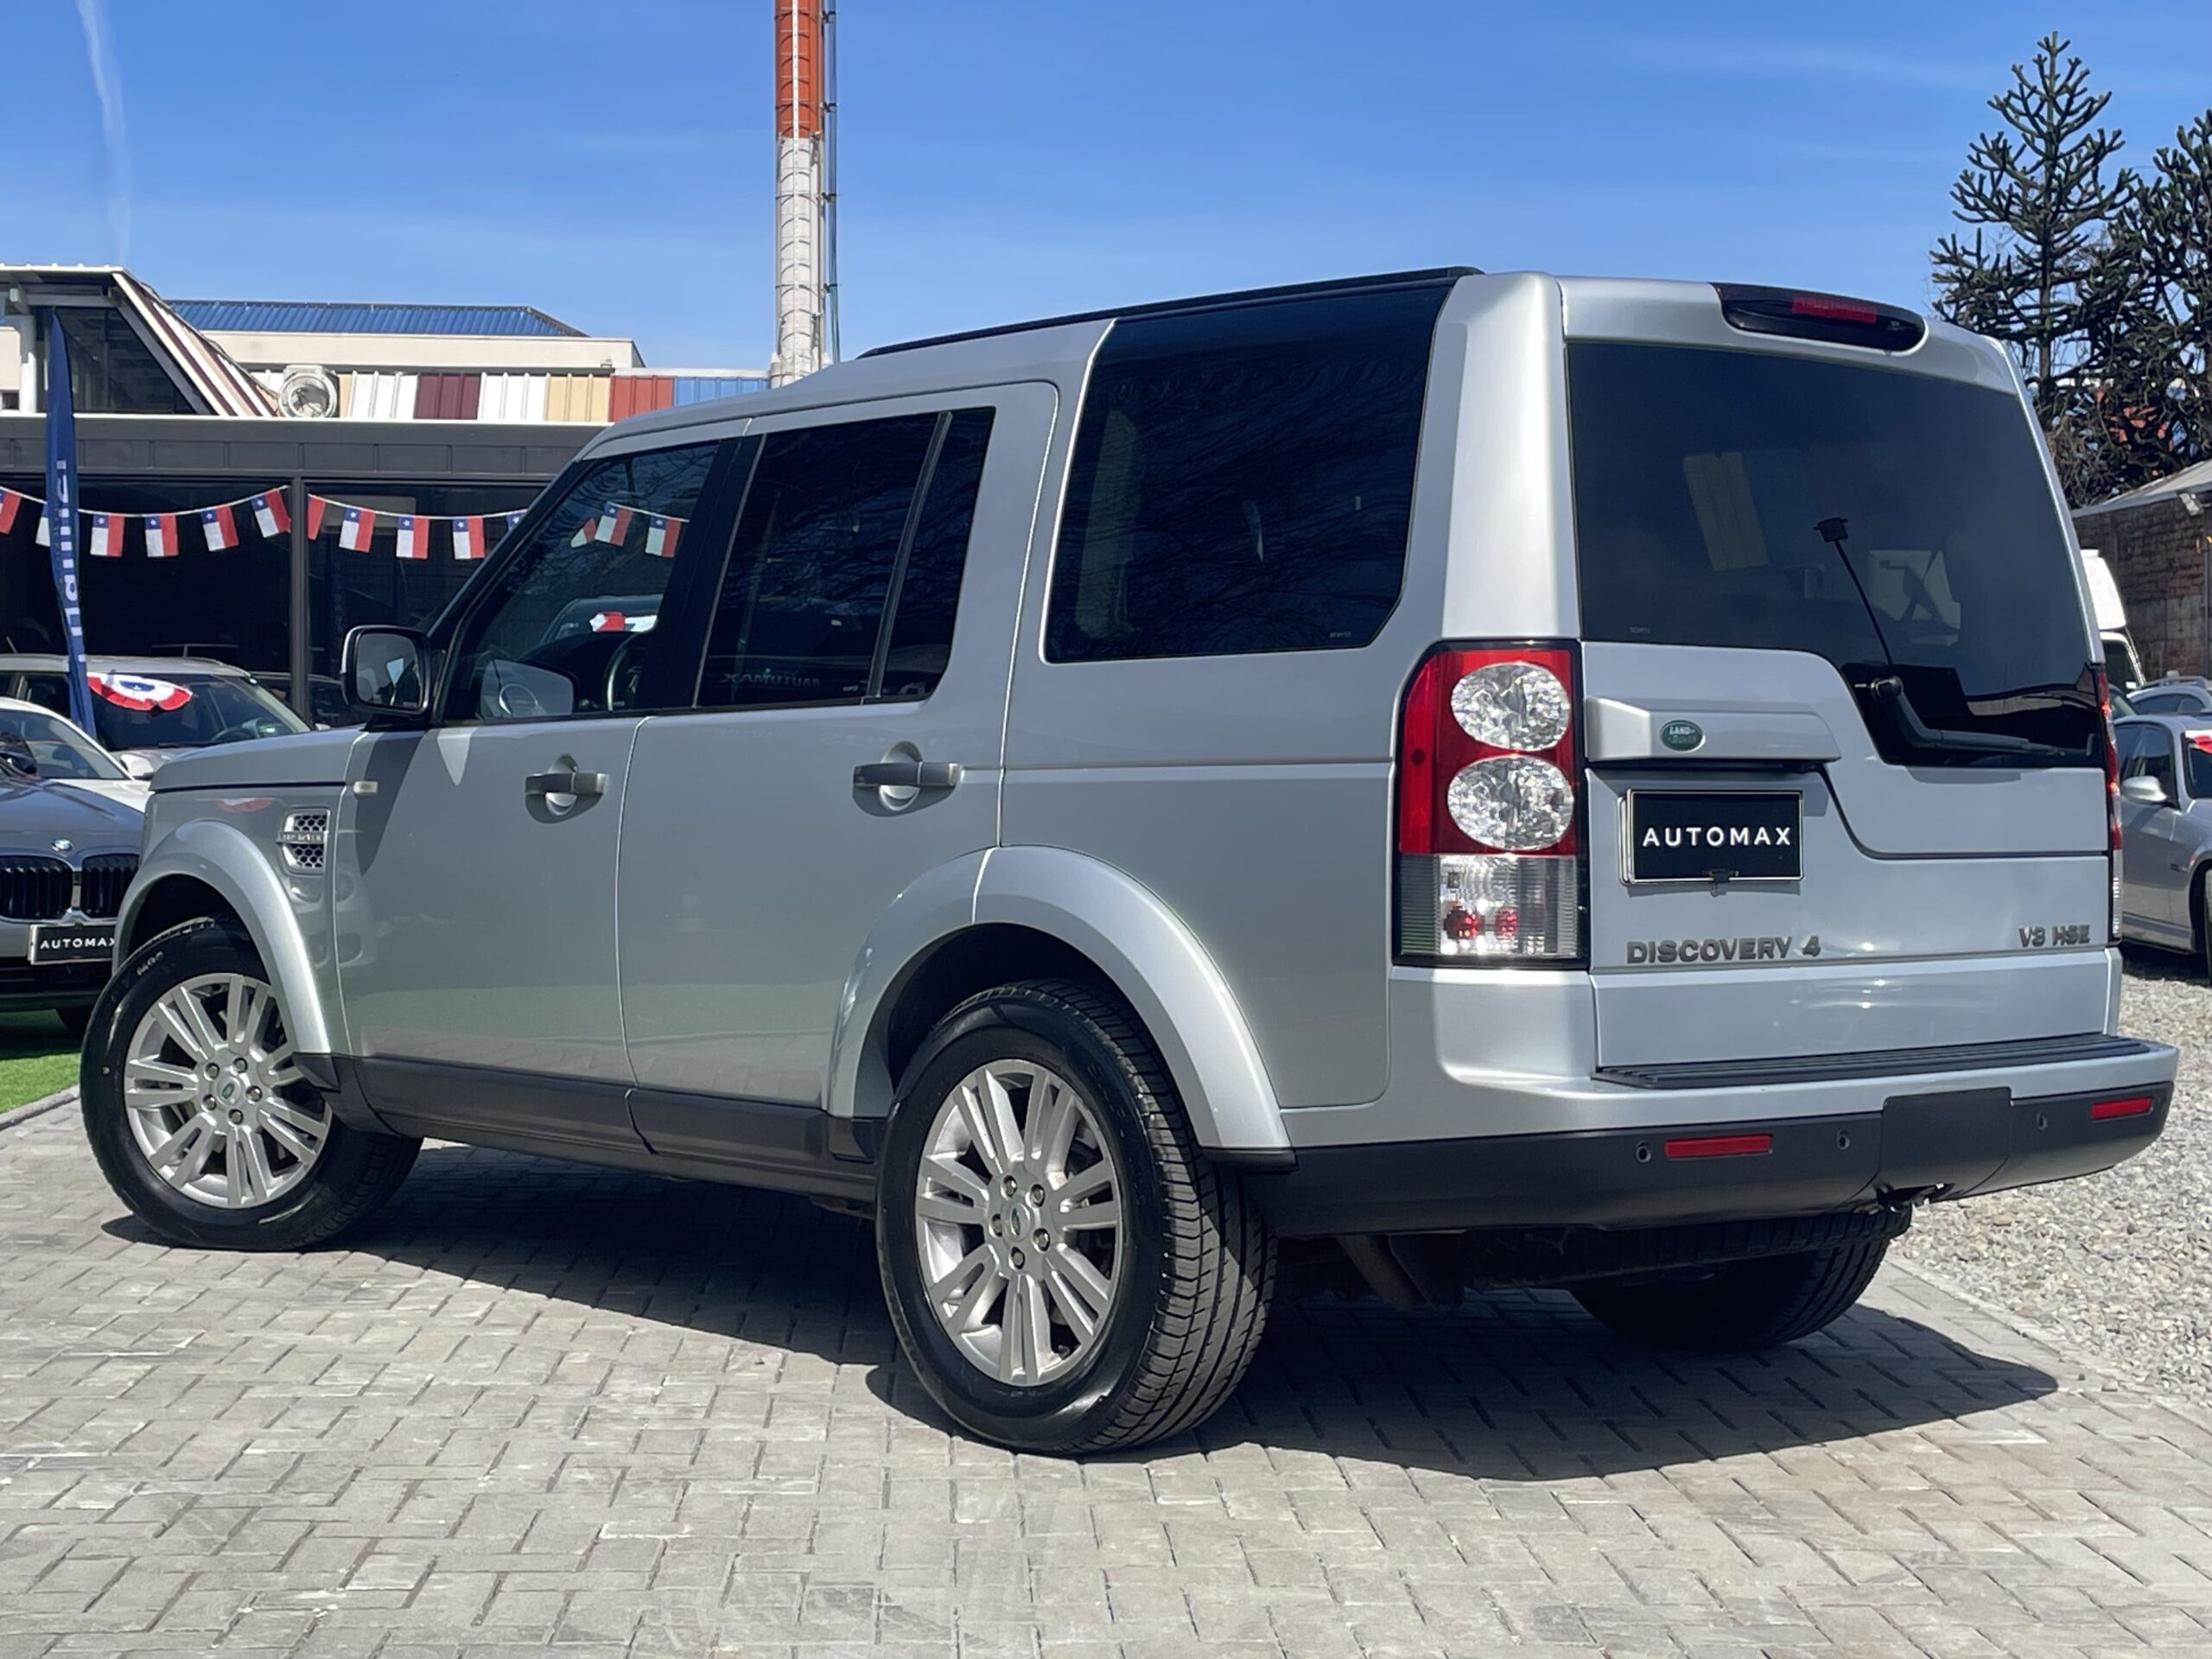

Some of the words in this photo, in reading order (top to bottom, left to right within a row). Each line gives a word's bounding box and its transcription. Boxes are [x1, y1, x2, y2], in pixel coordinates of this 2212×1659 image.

[1643, 826, 1791, 847] AUTOMAX
[2052, 925, 2090, 946] HSE
[1627, 937, 1792, 964] DISCOVERY
[1801, 936, 1821, 957] 4
